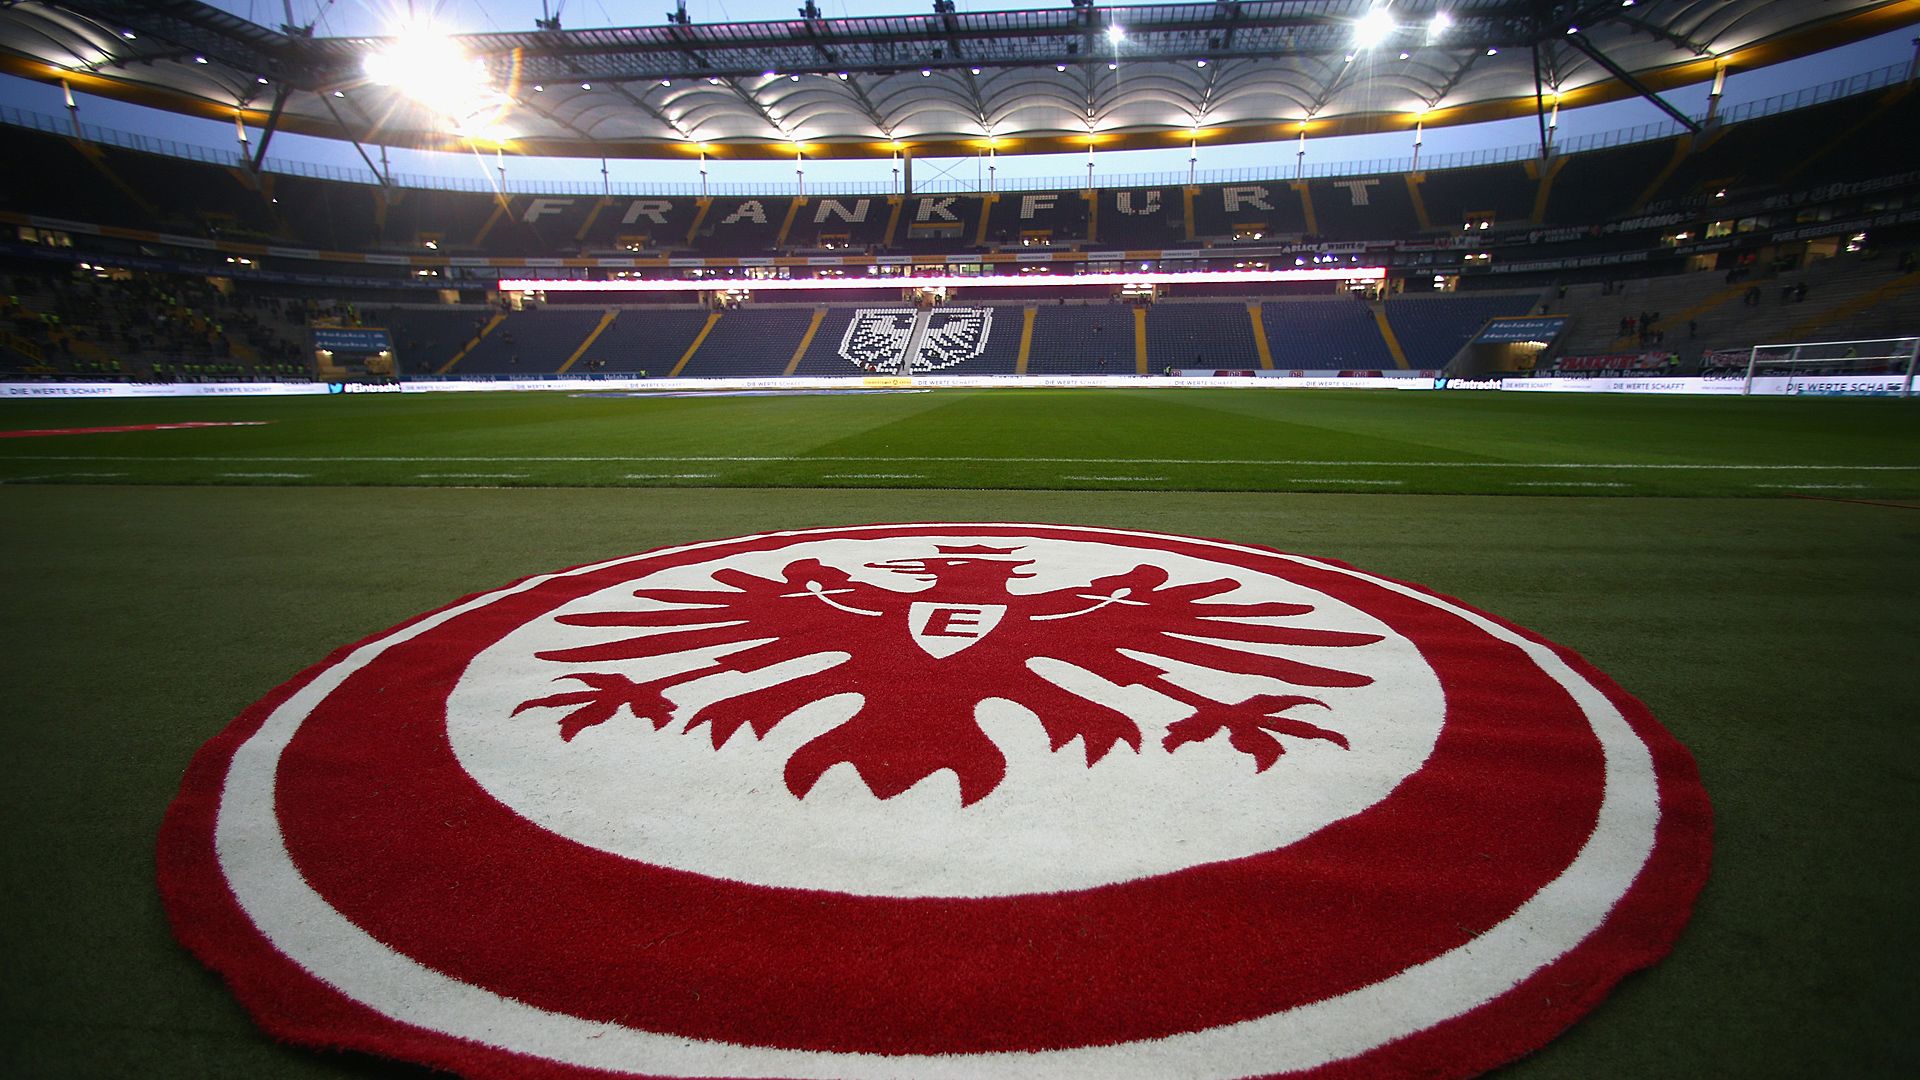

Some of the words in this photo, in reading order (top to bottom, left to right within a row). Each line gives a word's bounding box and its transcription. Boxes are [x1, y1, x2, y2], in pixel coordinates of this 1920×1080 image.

[522, 179, 1380, 224] FRANKFURT
[1291, 244, 1317, 252] BLACK
[1328, 243, 1355, 251] WHITE
[1534, 370, 1552, 378] Alfa
[1554, 370, 1587, 379] Romeo
[1600, 369, 1620, 378] Alfa
[1622, 369, 1660, 378] Romeo
[345, 383, 400, 393] #Eintracht
[1447, 379, 1502, 390] #Eintracht
[1786, 383, 1804, 391] DIE
[1807, 383, 1848, 391] WERTE
[1850, 383, 1908, 391] SCHAFF
[921, 608, 982, 638] E
